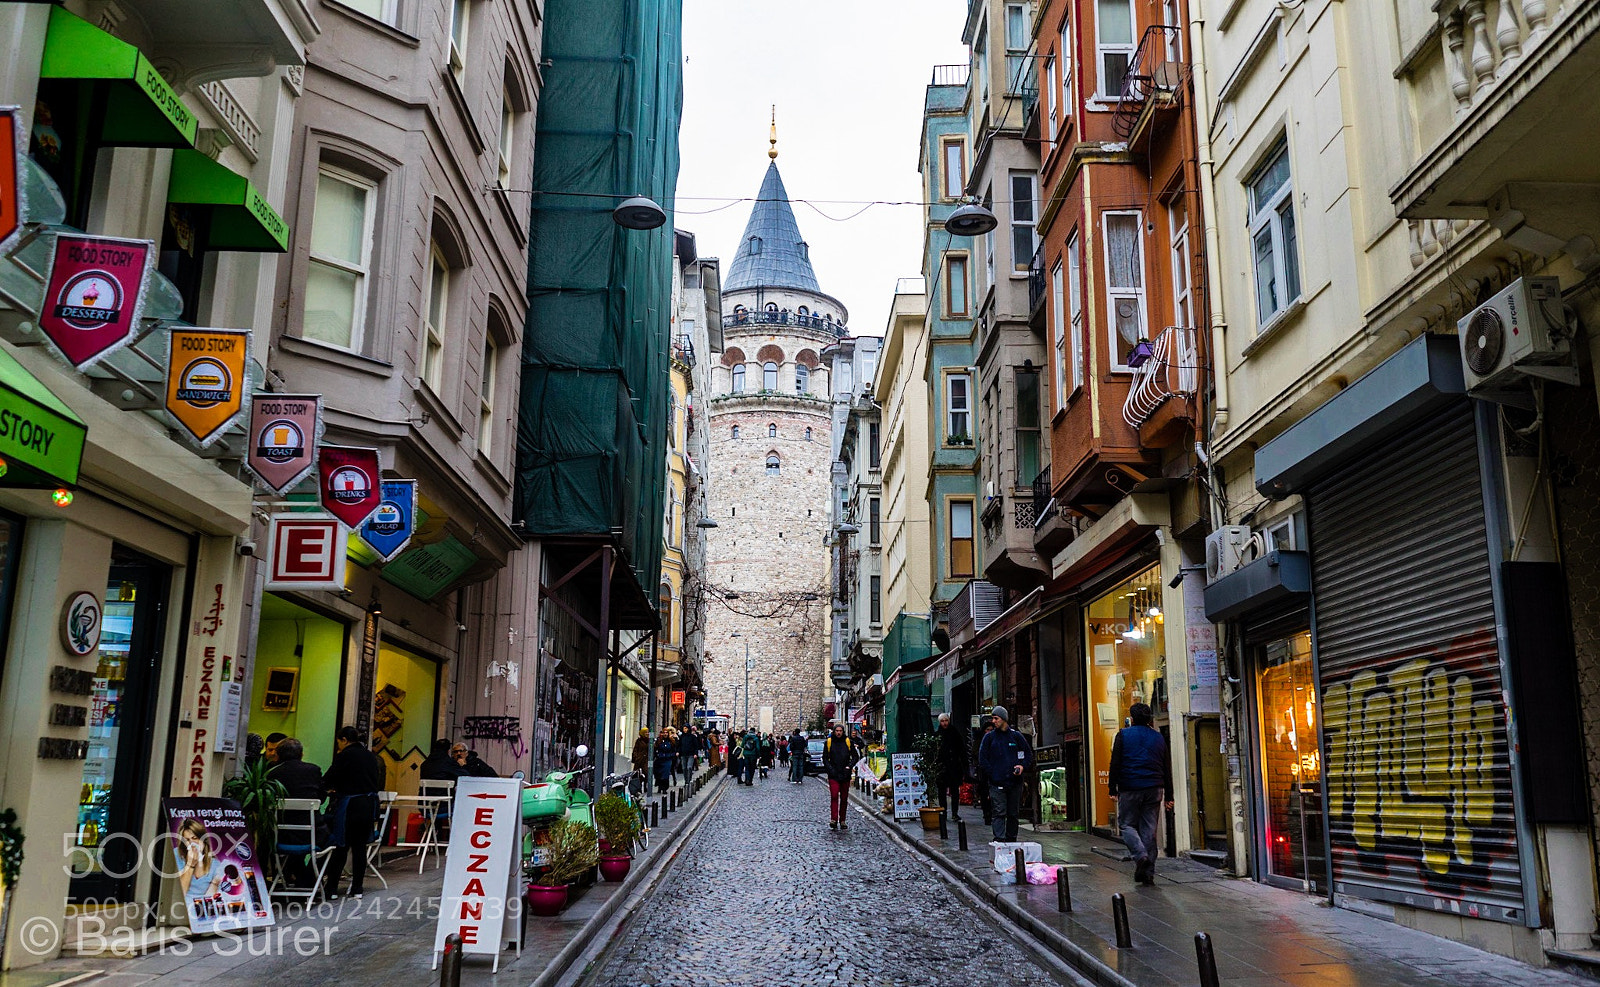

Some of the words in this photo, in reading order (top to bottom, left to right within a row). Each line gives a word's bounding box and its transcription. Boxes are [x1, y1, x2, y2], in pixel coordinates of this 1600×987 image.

[146, 70, 166, 105] FOOD
[166, 97, 190, 130] STORY
[253, 195, 267, 225] FOOD
[268, 216, 284, 239] STORY
[68, 247, 97, 264] FOOD
[99, 249, 135, 267] STORY
[62, 306, 115, 321] DESSERT
[181, 337, 206, 351] FOOD
[207, 338, 237, 353] STORY
[176, 390, 231, 401] SANDWICH
[261, 403, 282, 415] FOOD
[284, 403, 308, 416] STORY
[0, 409, 55, 456] STORY
[267, 448, 295, 456] TOAST
[334, 490, 366, 499] DRINKS
[387, 487, 407, 497] STORY
[375, 523, 398, 531] SALAD
[285, 529, 325, 573] E
[197, 646, 216, 720] ECZANE
[170, 808, 196, 820] Kışın
[197, 808, 223, 819] rengi
[459, 807, 495, 945] ECZANE
